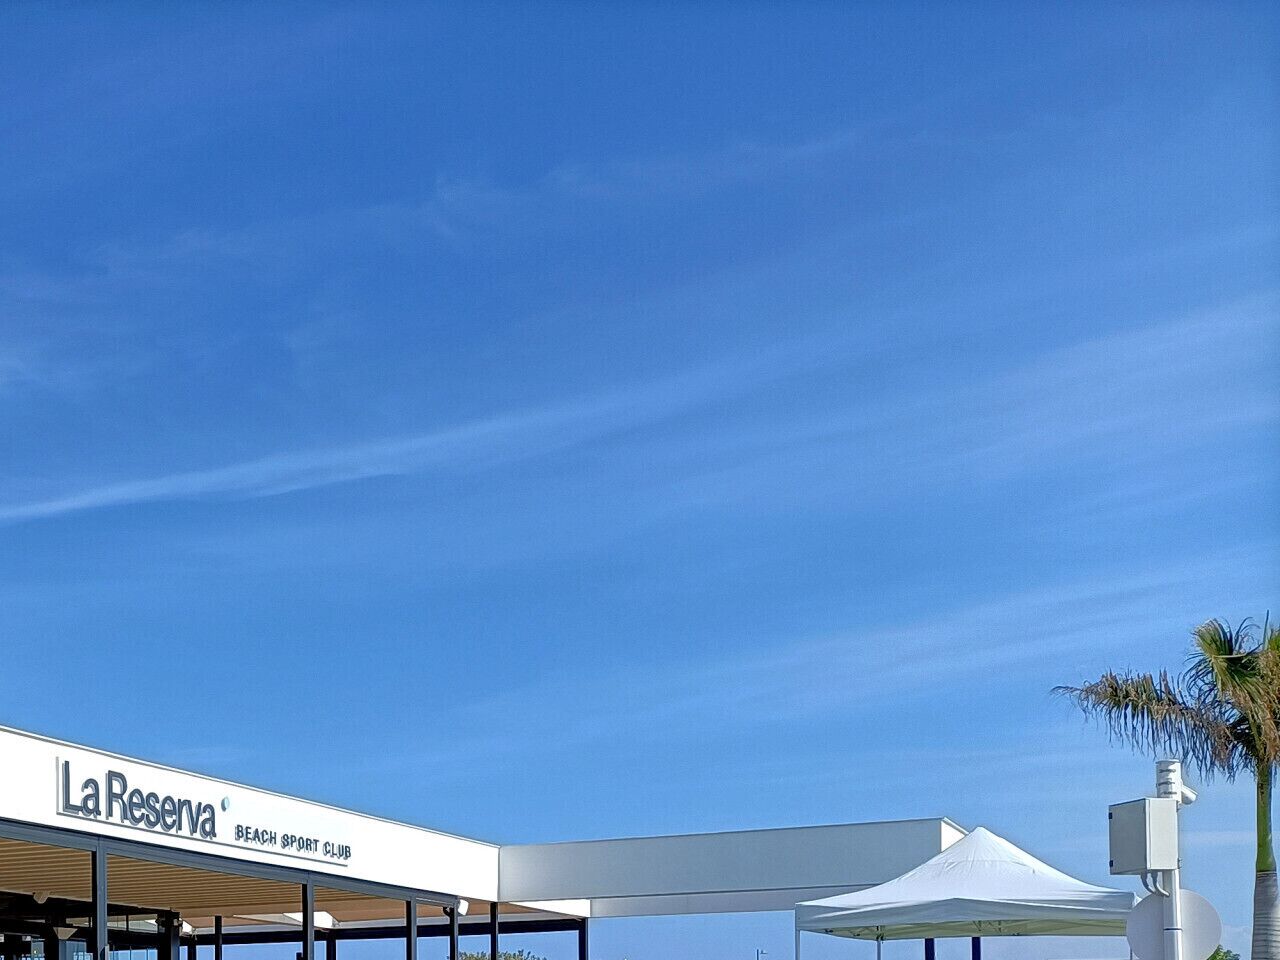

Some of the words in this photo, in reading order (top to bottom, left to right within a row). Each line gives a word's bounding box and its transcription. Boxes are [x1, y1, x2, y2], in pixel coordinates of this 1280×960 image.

[62, 760, 101, 818] La
[105, 769, 217, 840] Reserva
[235, 824, 277, 846] BEACH
[281, 833, 319, 854] SPORT
[323, 841, 351, 860] CLUB
